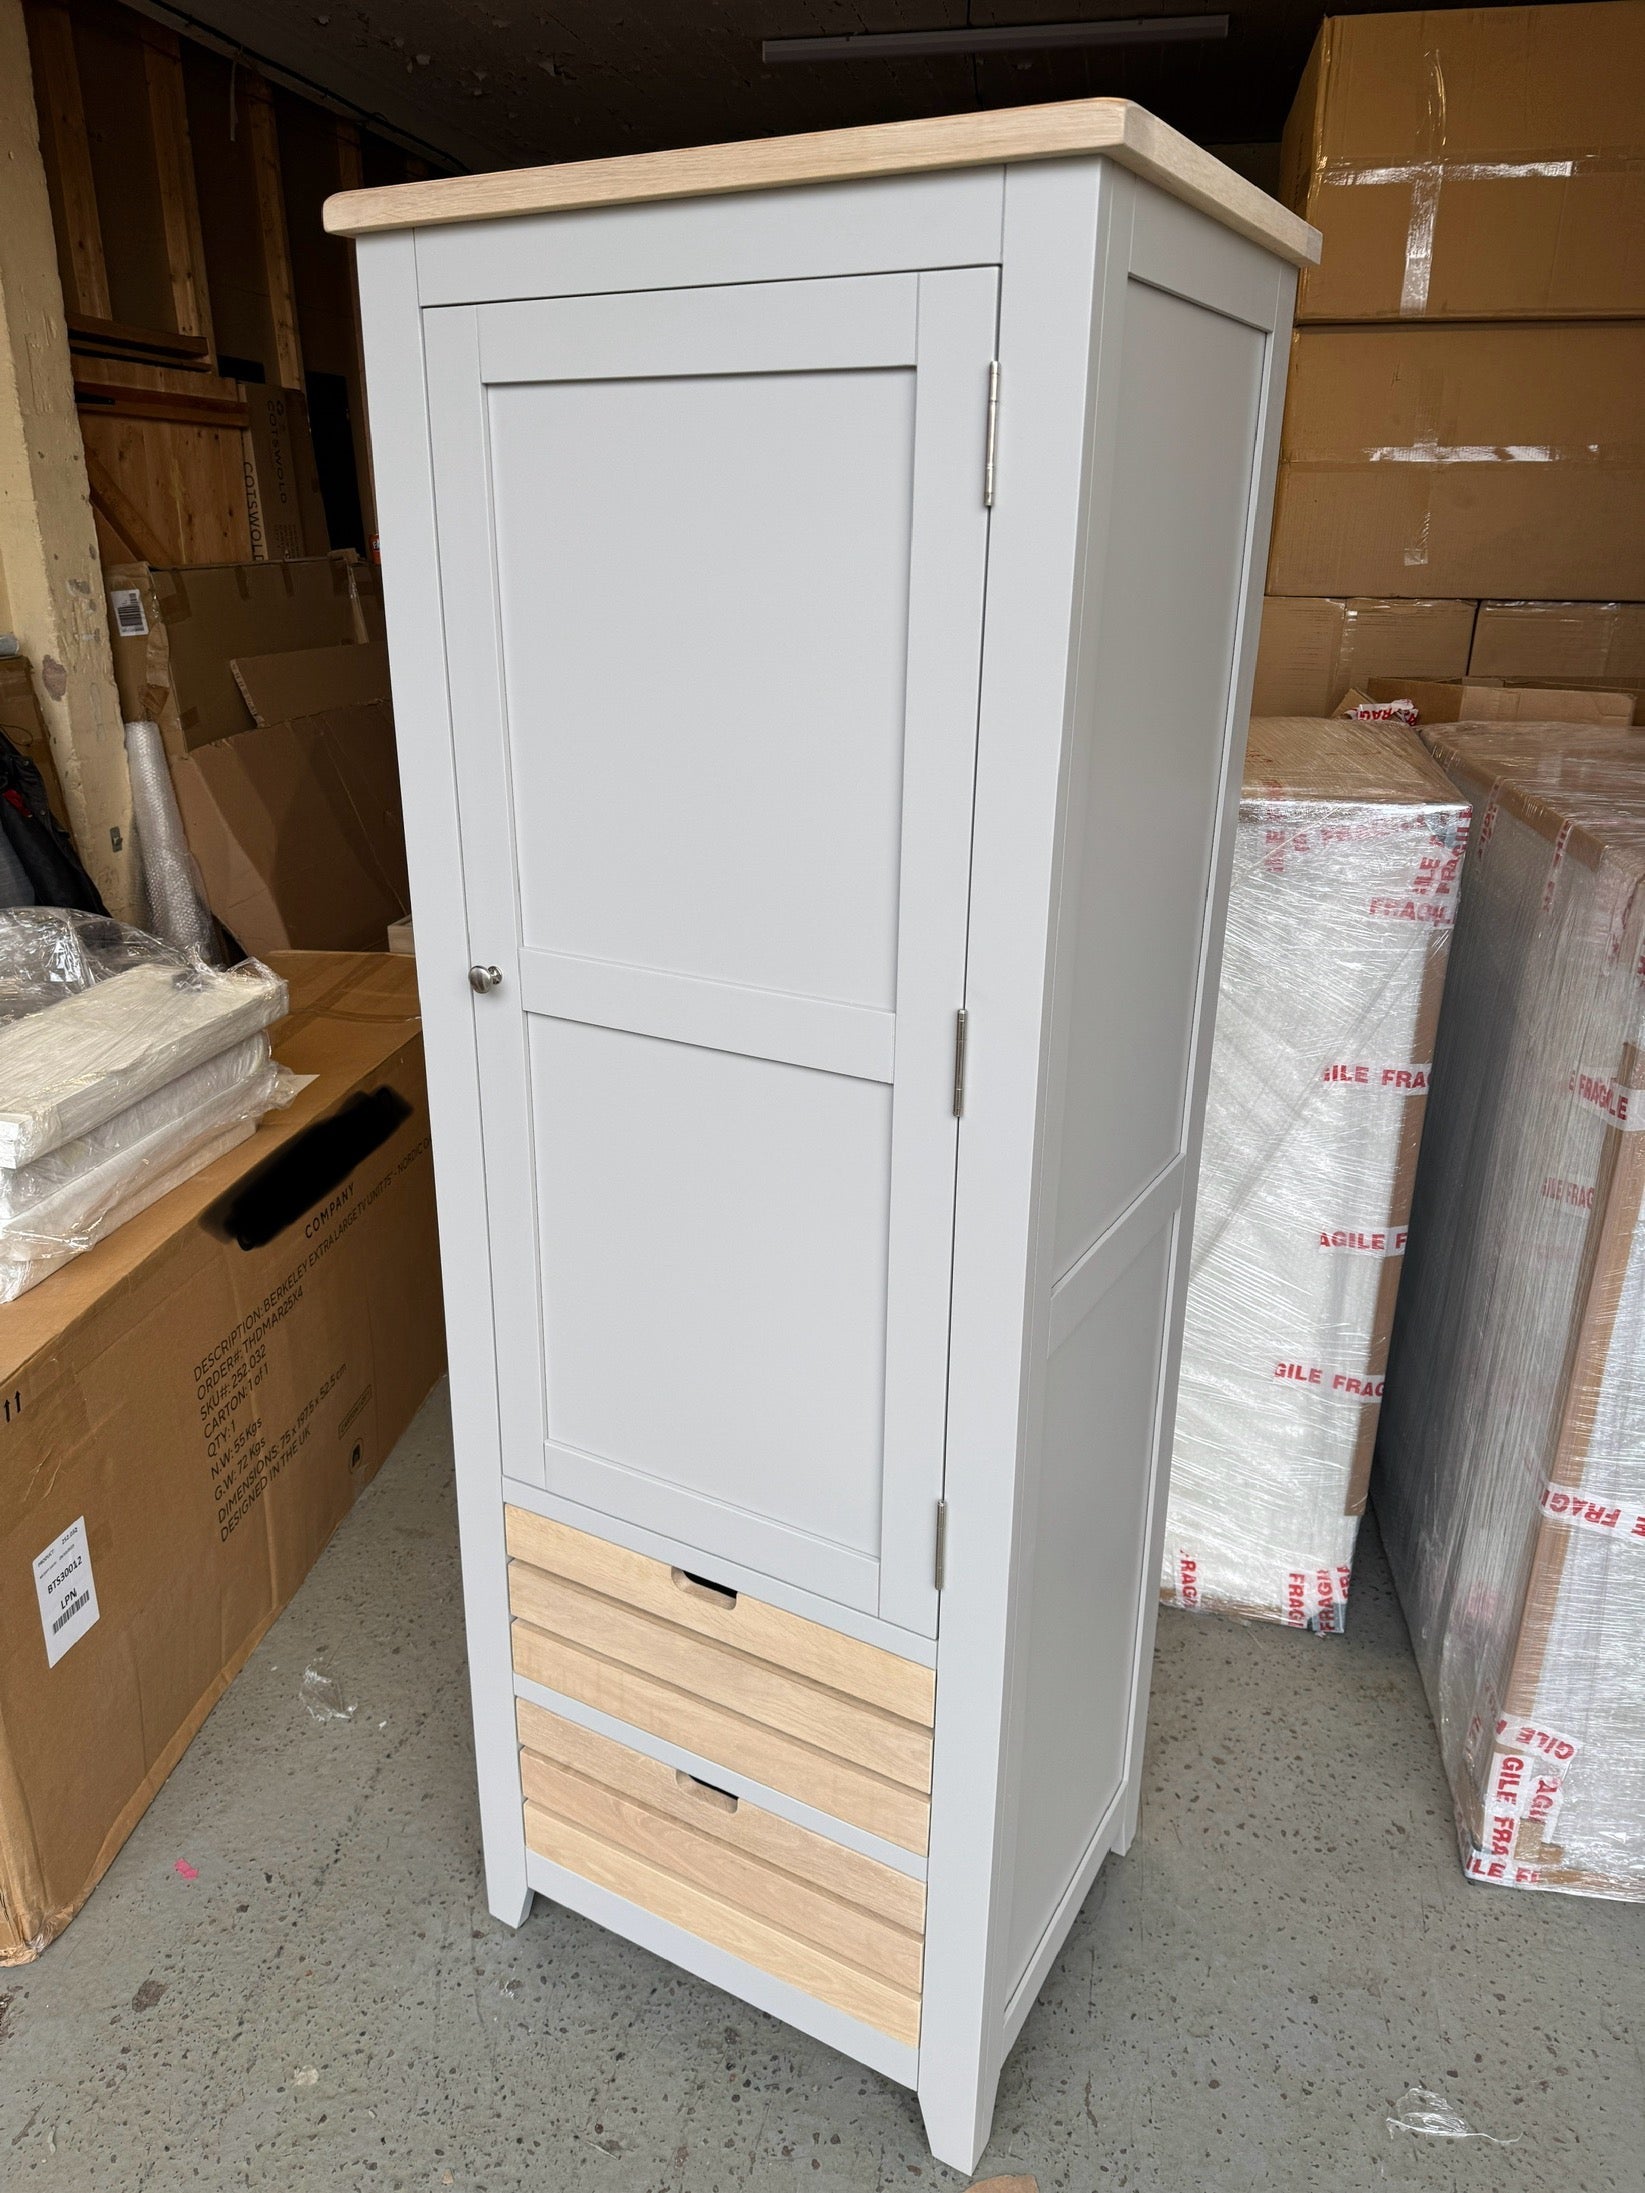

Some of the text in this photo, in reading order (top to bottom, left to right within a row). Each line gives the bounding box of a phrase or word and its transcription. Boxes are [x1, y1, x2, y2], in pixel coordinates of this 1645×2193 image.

[267, 400, 287, 503] COTSWOLD
[1381, 1069, 1430, 1089] FRA
[305, 1182, 354, 1239] COMPANY
[193, 1307, 264, 1382] DESCRIPTION:
[263, 1259, 307, 1313] BERKELEY
[309, 1234, 335, 1267] EXTRA
[334, 1207, 358, 1240] LARGE
[197, 1285, 303, 1401] ORDER#: THDMAR25X4
[200, 1344, 266, 1421] SKU#: 252.032
[204, 1386, 248, 1439] CARTON:
[254, 1365, 263, 1386] of
[207, 1427, 231, 1458] QTY:
[210, 1417, 262, 1480] N.W: 55 Kgs
[214, 1436, 266, 1501] G.W: 72 Kgs
[218, 1444, 280, 1524] DIMENSIONS:
[280, 1429, 291, 1450] 75
[221, 1424, 311, 1543] DESIGNED IN THE UK
[47, 1555, 83, 1594] BTS30012
[60, 1588, 78, 1610] LPN
